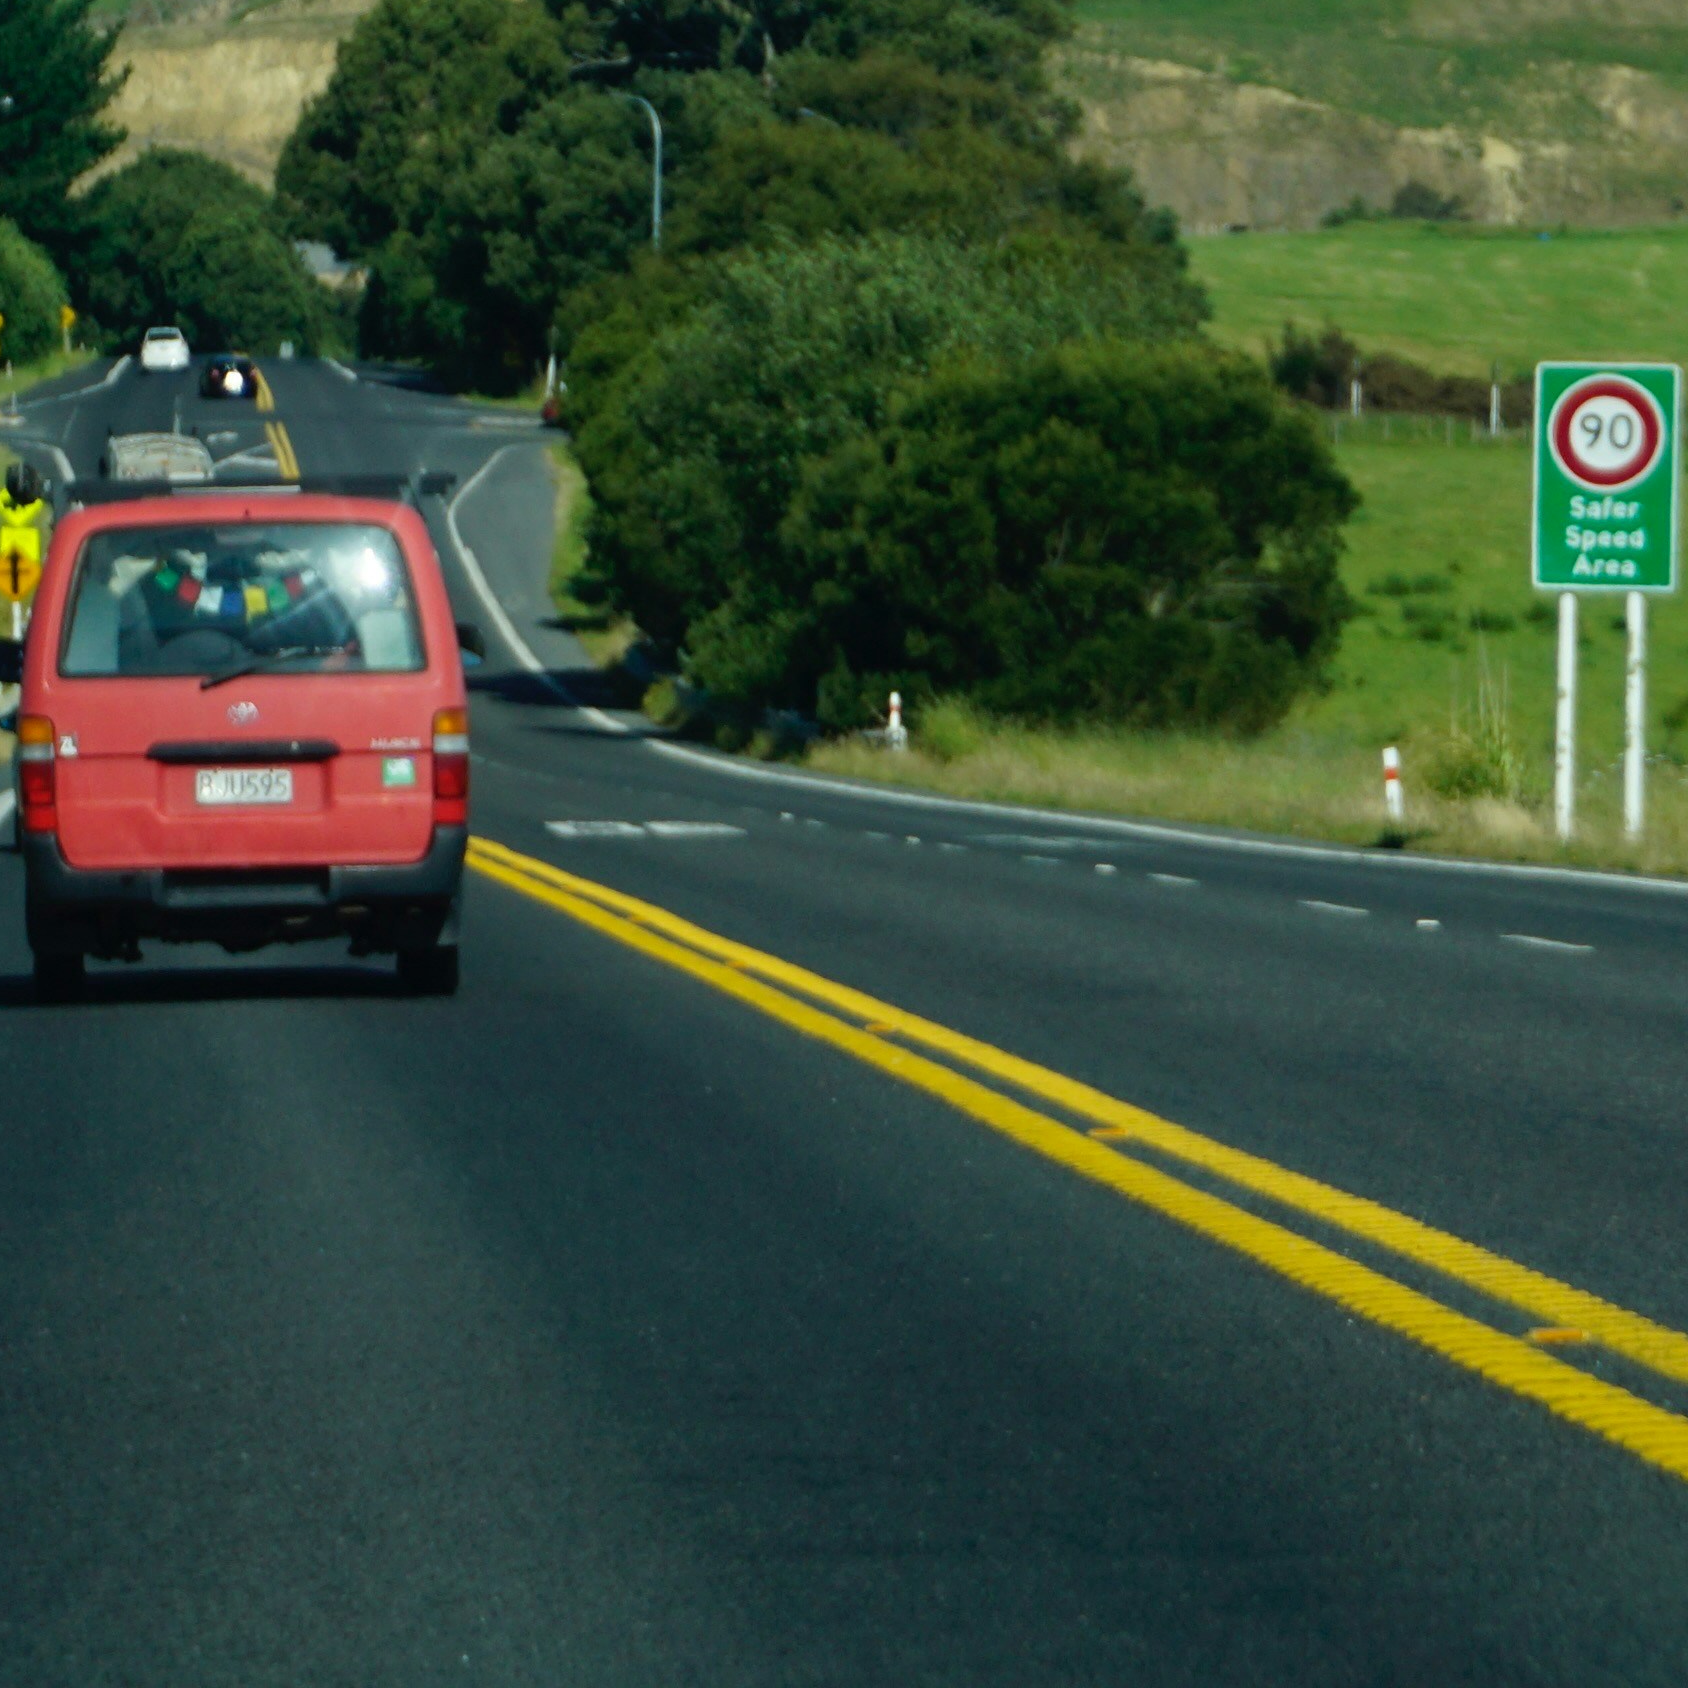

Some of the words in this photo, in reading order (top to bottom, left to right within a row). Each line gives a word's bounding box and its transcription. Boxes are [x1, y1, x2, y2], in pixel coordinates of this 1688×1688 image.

[1580, 413, 1634, 449] 90
[1570, 495, 1641, 520] Safer
[1565, 525, 1646, 552] Speed
[1572, 552, 1637, 578] Area
